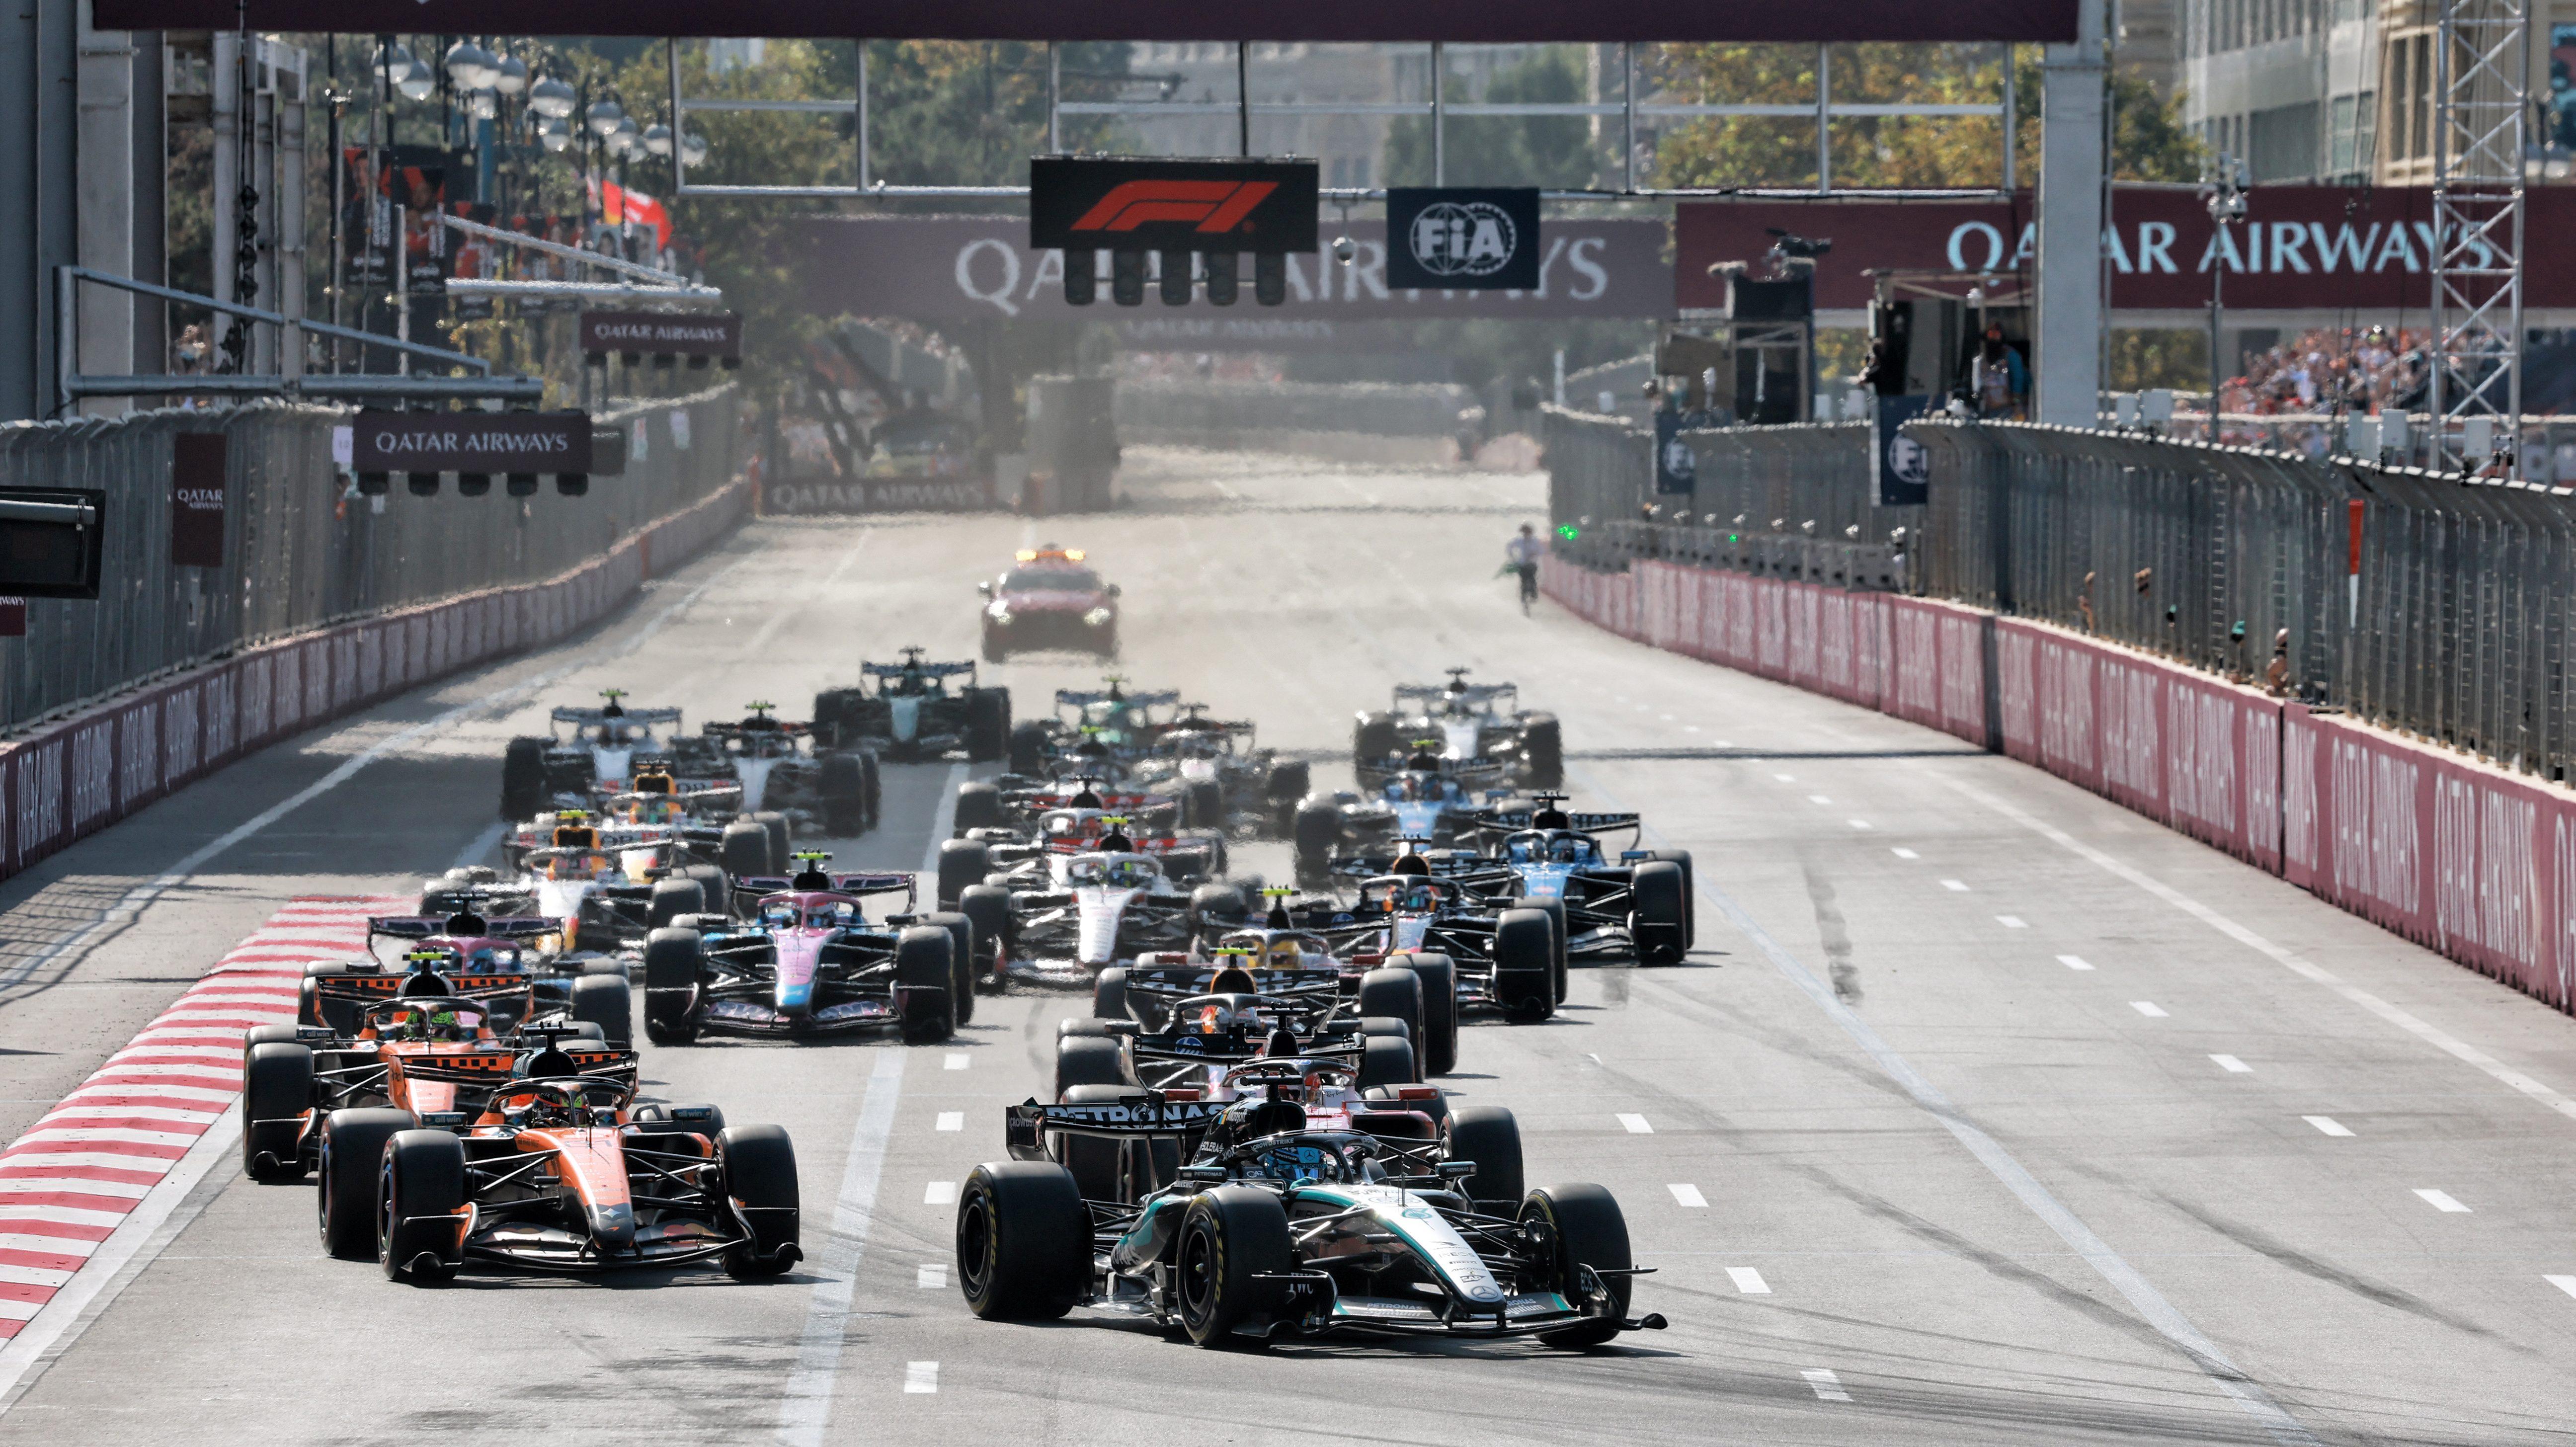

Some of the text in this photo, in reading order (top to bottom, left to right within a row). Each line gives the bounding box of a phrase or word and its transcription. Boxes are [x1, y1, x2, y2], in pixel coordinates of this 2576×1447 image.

[1946, 220, 2179, 287] QAAR
[594, 323, 726, 341] QATAR AIRWAYS
[375, 431, 568, 454] QATAR AIRWAYS
[177, 488, 223, 505] QATAR
[1225, 1108, 1248, 1124] Microsoft
[1252, 1138, 1294, 1151] CROWDSTRIKE
[1275, 1153, 1297, 1161] CROWDSTRIKE
[1367, 1302, 1423, 1311] PETRONAS
